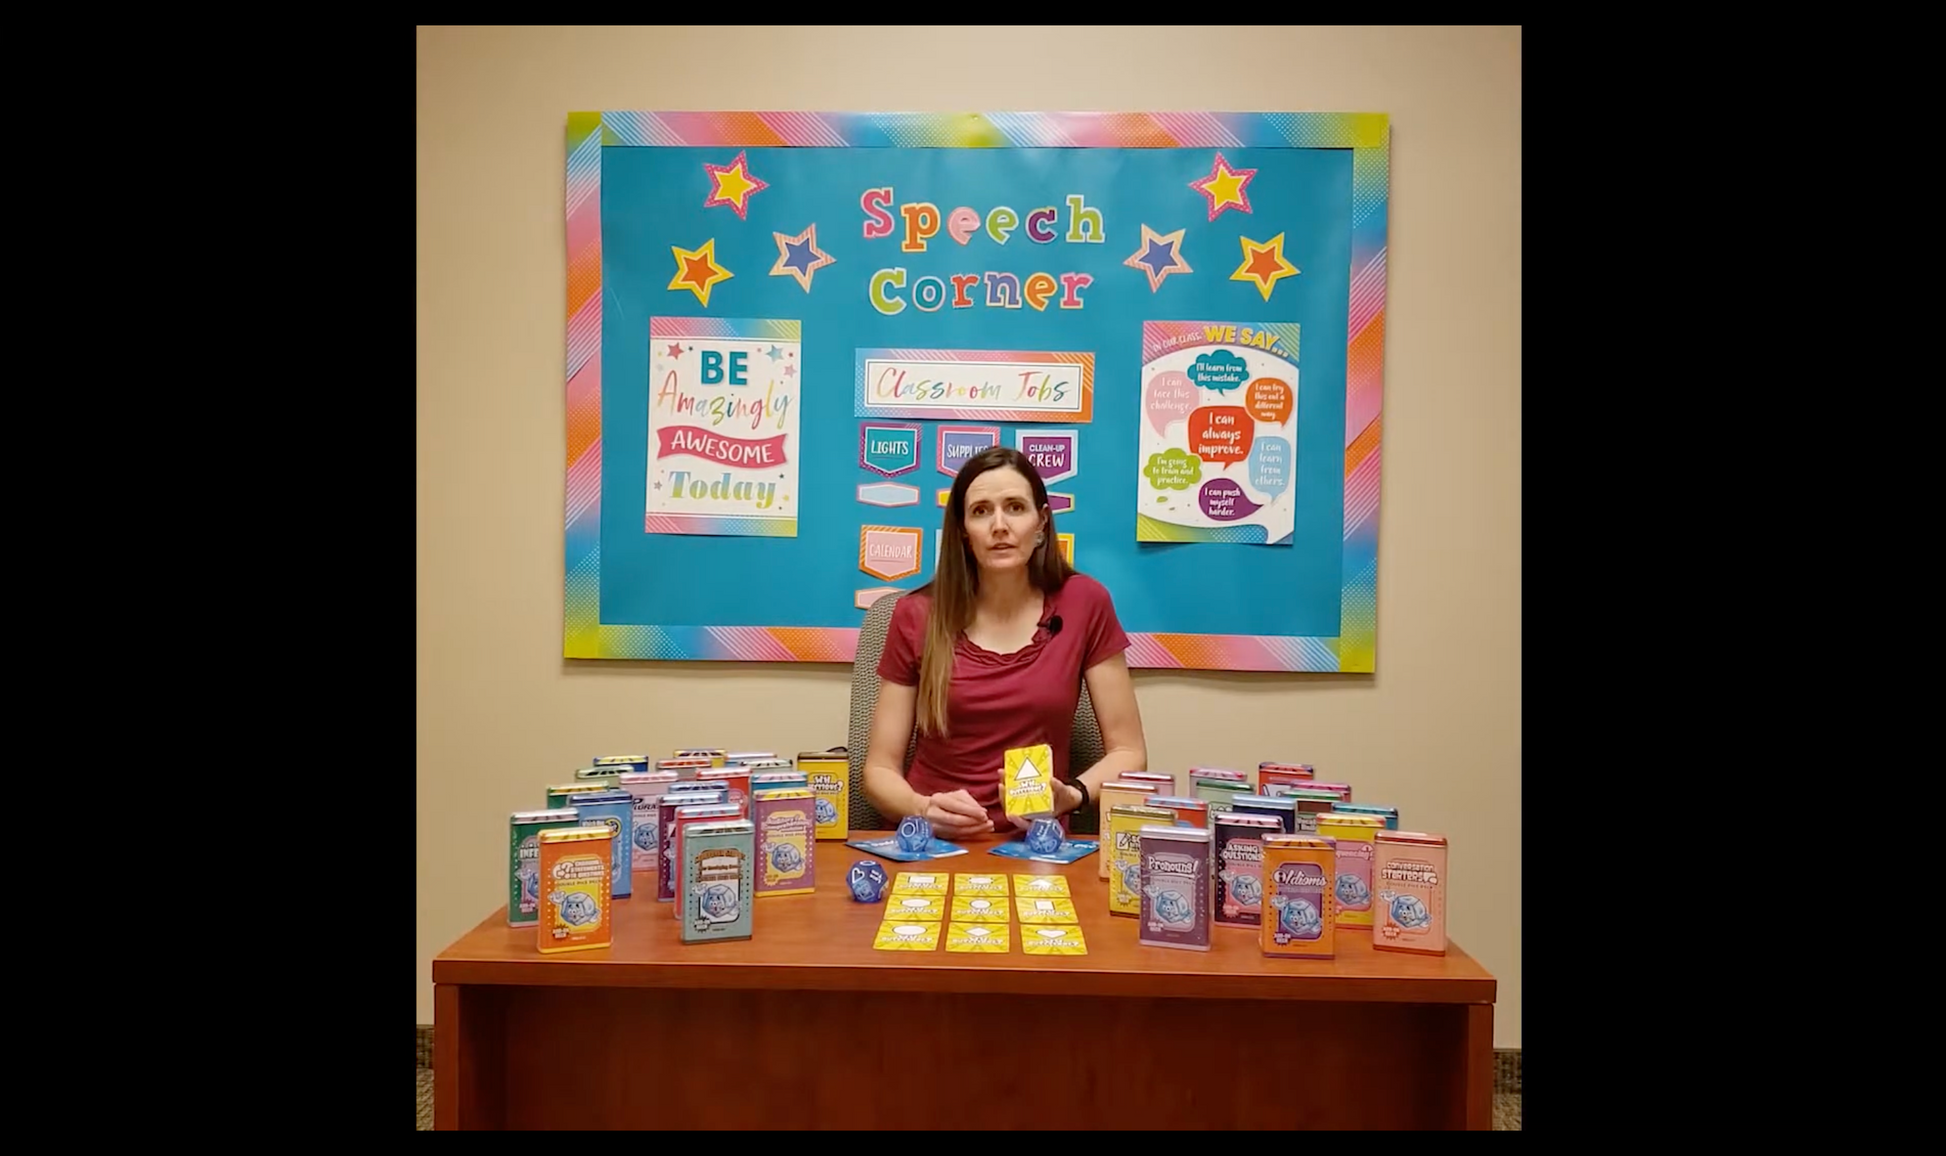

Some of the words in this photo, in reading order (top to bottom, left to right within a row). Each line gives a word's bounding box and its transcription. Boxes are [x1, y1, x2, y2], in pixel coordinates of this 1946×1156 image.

[861, 187, 1105, 252] Speech
[869, 267, 1094, 315] Corner
[1203, 325, 1236, 343] WE
[1240, 326, 1289, 358] SAY...
[701, 350, 748, 386] BE
[1206, 363, 1225, 371] learn
[1226, 364, 1243, 372] from
[876, 366, 1002, 400] Classroom
[1014, 371, 1072, 402] Jobs
[1167, 378, 1182, 387] can
[1198, 373, 1211, 382] this
[1212, 373, 1241, 382] mistake.
[1154, 388, 1173, 398] face
[1174, 388, 1190, 399] this
[1273, 384, 1284, 394] try
[657, 370, 792, 430] Amazingly
[1255, 392, 1267, 400] this
[1151, 399, 1193, 415] challenge.
[1255, 401, 1284, 410] different
[1215, 413, 1235, 425] can
[1202, 427, 1241, 445] always
[671, 430, 775, 464] AWESOME
[870, 440, 910, 456] LIGHTS
[1028, 444, 1066, 453] CLEAN-UP
[1198, 443, 1244, 459] improve.
[1266, 443, 1282, 452] can
[1028, 453, 1065, 468] CREW
[1157, 456, 1167, 465] I'm
[1168, 458, 1187, 469] going
[1259, 453, 1283, 464] learn
[1152, 466, 1161, 475] to
[1161, 466, 1179, 475] train
[1180, 467, 1194, 476] and
[1260, 465, 1282, 475] from
[1157, 475, 1189, 486] practice.
[1255, 475, 1286, 486] others.
[669, 471, 777, 510] Today
[1209, 489, 1222, 497] can
[1222, 487, 1241, 500] push
[1209, 498, 1236, 511] myself
[1208, 508, 1236, 517] harder.
[869, 544, 914, 559] CALENDAR
[814, 774, 832, 784] WH
[1228, 843, 1259, 854] ASKING
[1148, 856, 1200, 874] Pronouns!
[1285, 869, 1328, 887] Idioms
